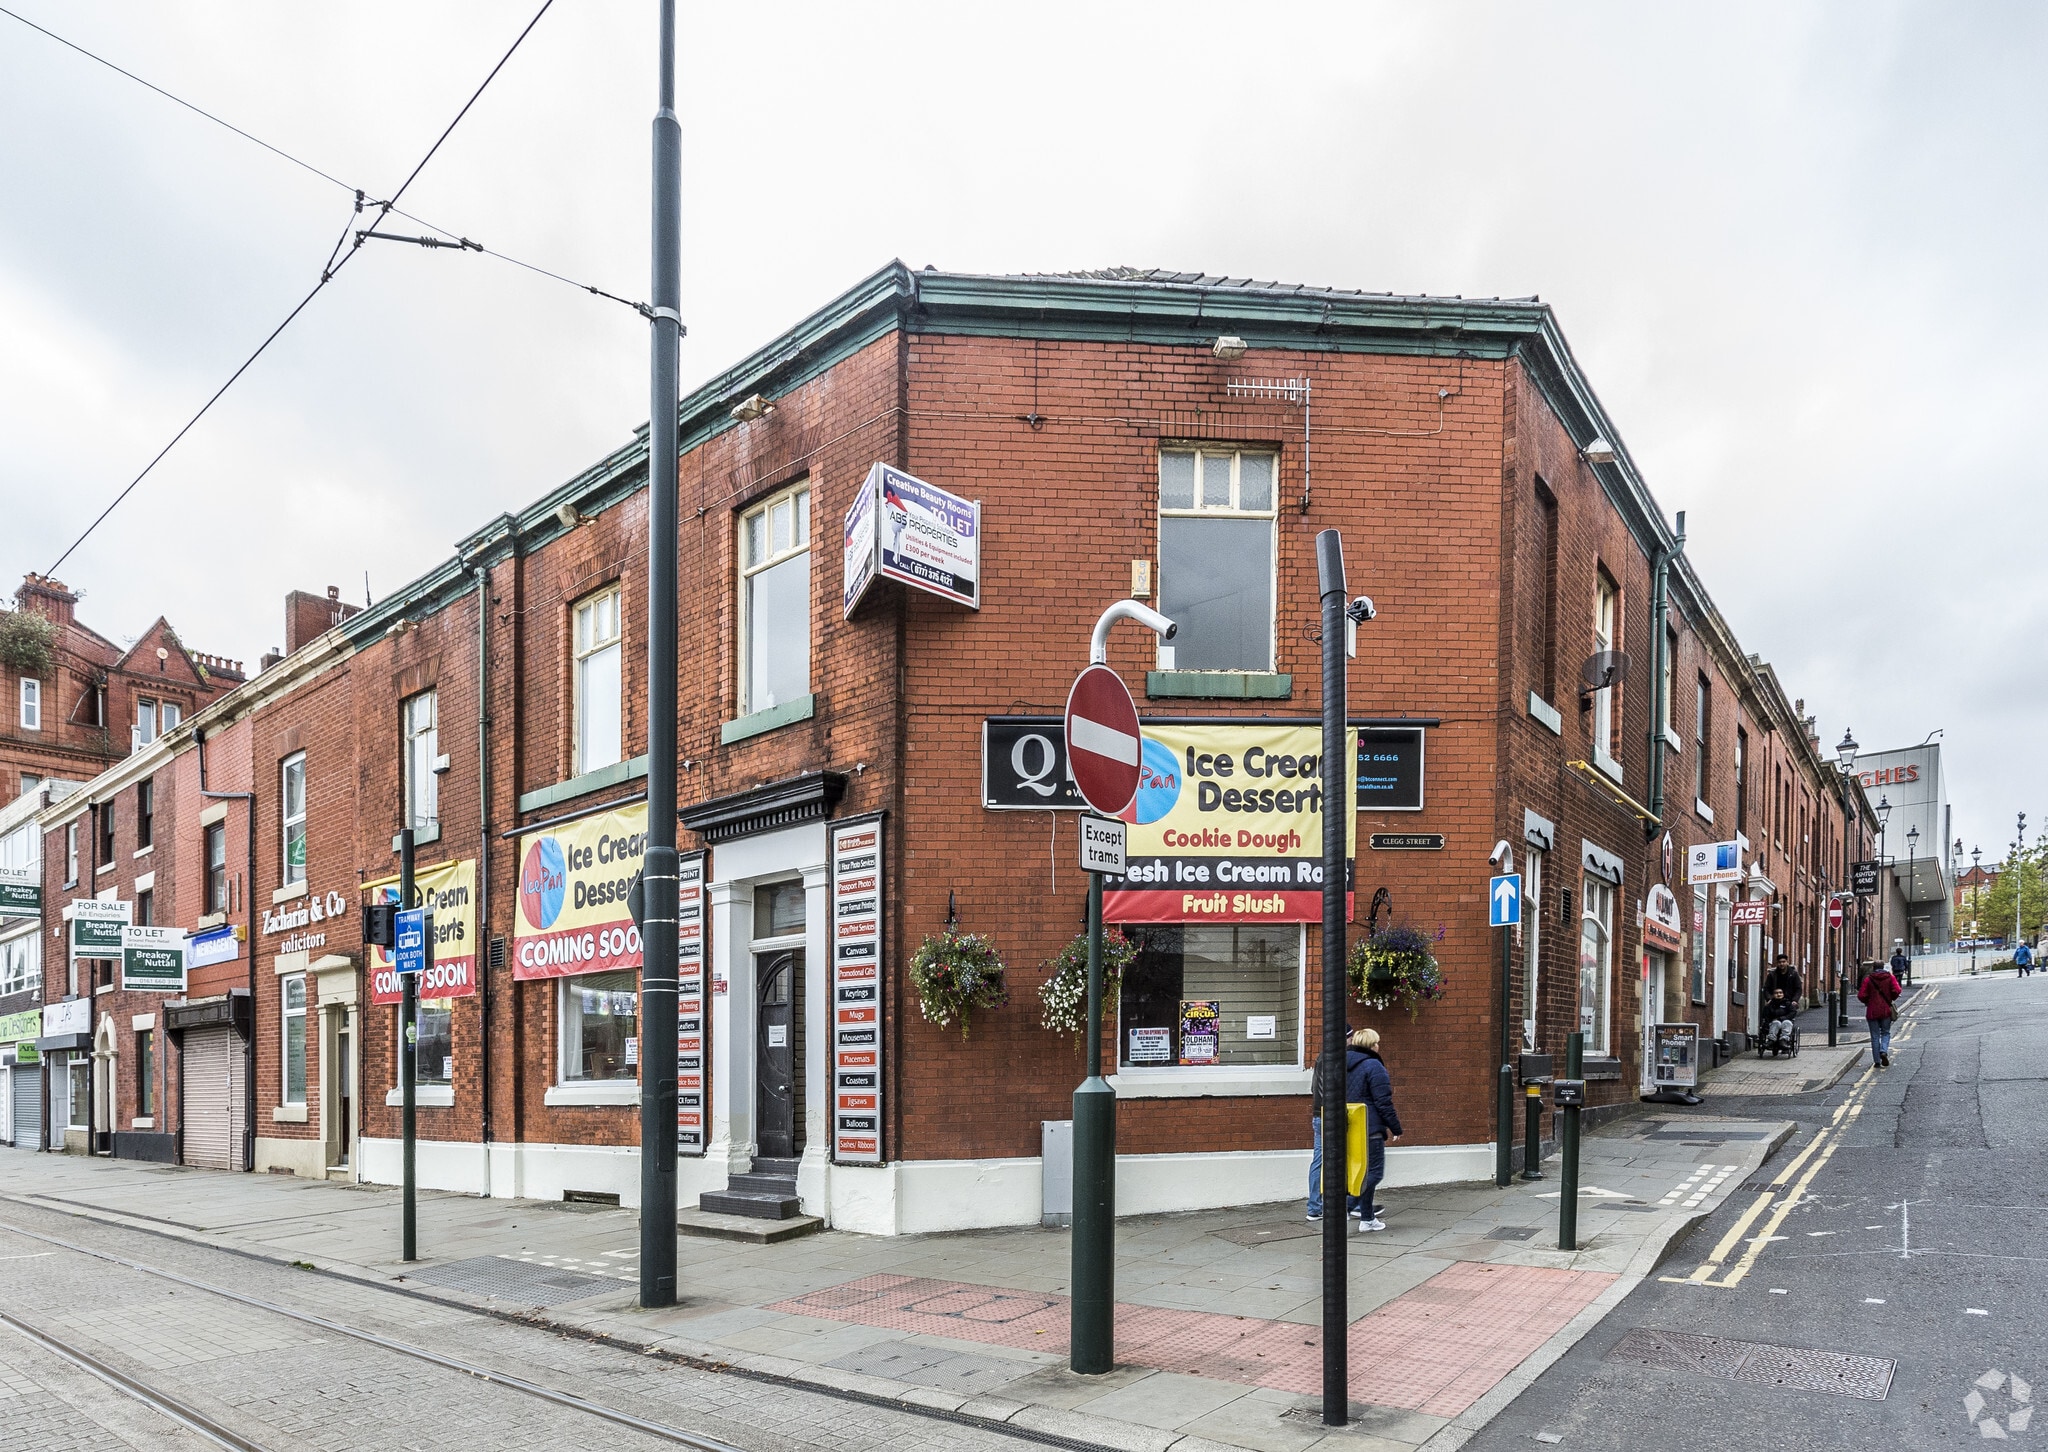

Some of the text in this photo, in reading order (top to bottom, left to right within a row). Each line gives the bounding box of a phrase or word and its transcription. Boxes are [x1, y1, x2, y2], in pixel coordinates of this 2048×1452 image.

[887, 473, 972, 519] Creative Beauty Rooms
[931, 506, 971, 535] TO LET
[890, 511, 958, 548] ABS PROPERTIES
[906, 534, 924, 546] Utilities
[929, 543, 953, 558] Equipment
[954, 551, 972, 565] included
[906, 544, 944, 565] £300 per week
[1186, 746, 1323, 778] Ice Crea
[1139, 765, 1175, 789] Pan
[1859, 765, 1917, 788] GHES
[1198, 780, 1323, 813] Dessert
[1086, 824, 1122, 847] Except
[1163, 828, 1301, 853] Cookie Dough
[568, 844, 592, 872] Ice
[1089, 846, 1119, 864] trams
[851, 861, 860, 869] Photo
[861, 859, 875, 867] Services
[1175, 860, 1209, 883] Ice
[1216, 861, 1291, 883] Cream
[1714, 872, 1737, 880] Phones
[1854, 870, 1876, 878] ASHTON
[5, 886, 33, 894] Breakey
[574, 869, 640, 910] Desser
[839, 879, 875, 891] Passport Photo's
[426, 885, 468, 911] Cream
[1183, 893, 1285, 913] Fruit Slush
[101, 903, 125, 911] SALE
[849, 903, 860, 911] Format
[861, 901, 876, 910] Printing
[263, 891, 346, 934] Zacharia & Co
[398, 913, 420, 923] TRAMWAY
[1733, 907, 1765, 919] ACE
[86, 922, 118, 930] Breakey
[434, 918, 464, 944] serts
[859, 924, 875, 932] Services
[281, 931, 326, 953] solicitors
[520, 925, 643, 967] COMING SOO
[136, 951, 171, 960] Breakey
[397, 949, 422, 961] LOOK BOTH
[145, 959, 175, 967] Nuttall
[403, 960, 416, 969] WAYS
[426, 962, 467, 990] SOON
[839, 967, 875, 977] Promotional Gifts
[845, 989, 868, 998] Keyrings
[683, 1003, 698, 1011] Printing
[849, 1011, 864, 1020] Mugs
[679, 1022, 695, 1030] eaflets
[842, 1034, 872, 1042] Mousemats
[844, 1055, 870, 1063] Placemats
[845, 1076, 868, 1085] Coasters
[847, 1097, 867, 1107] Jigsaws
[846, 1119, 868, 1127] Balloons
[857, 1140, 875, 1149] Ribbons
